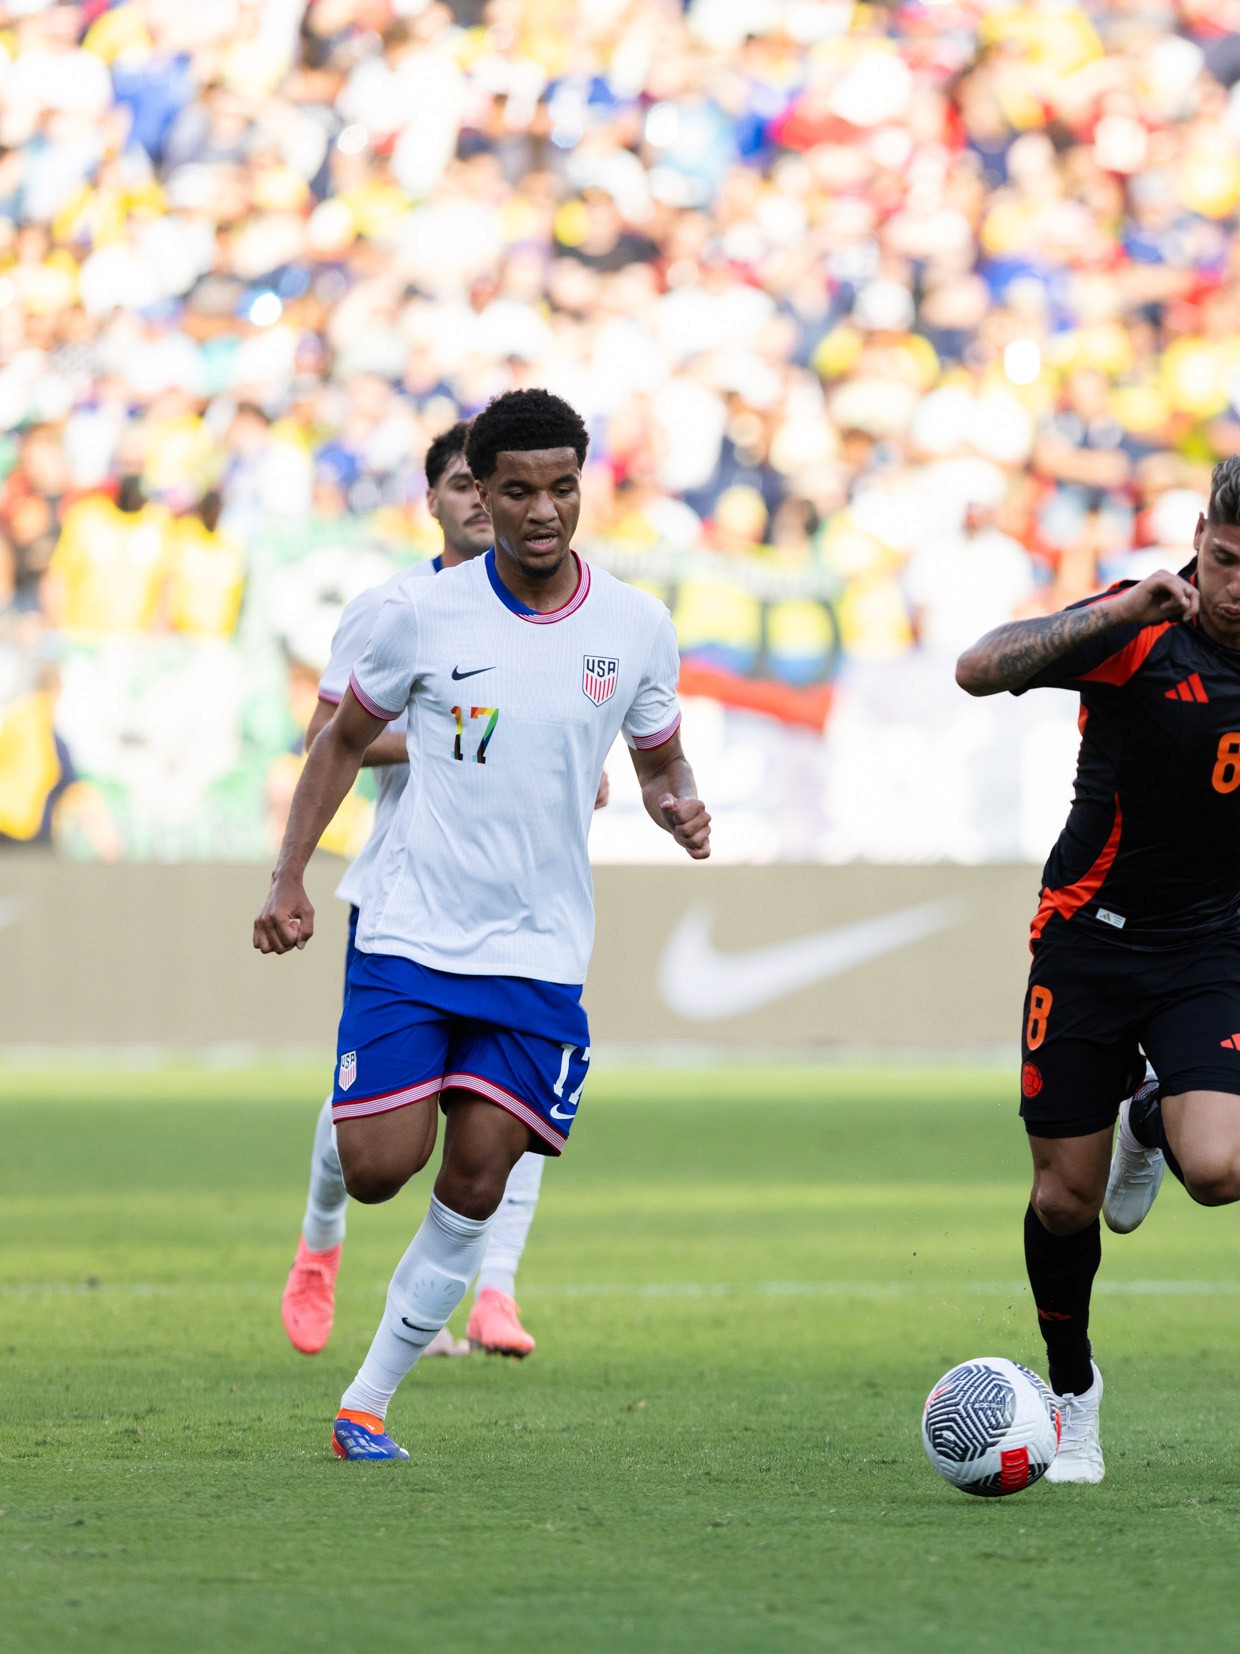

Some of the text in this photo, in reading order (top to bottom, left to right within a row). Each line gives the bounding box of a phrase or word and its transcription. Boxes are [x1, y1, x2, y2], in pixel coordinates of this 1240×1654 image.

[586, 658, 616, 678] USA
[450, 705, 499, 764] 17
[1026, 984, 1053, 1051] 8
